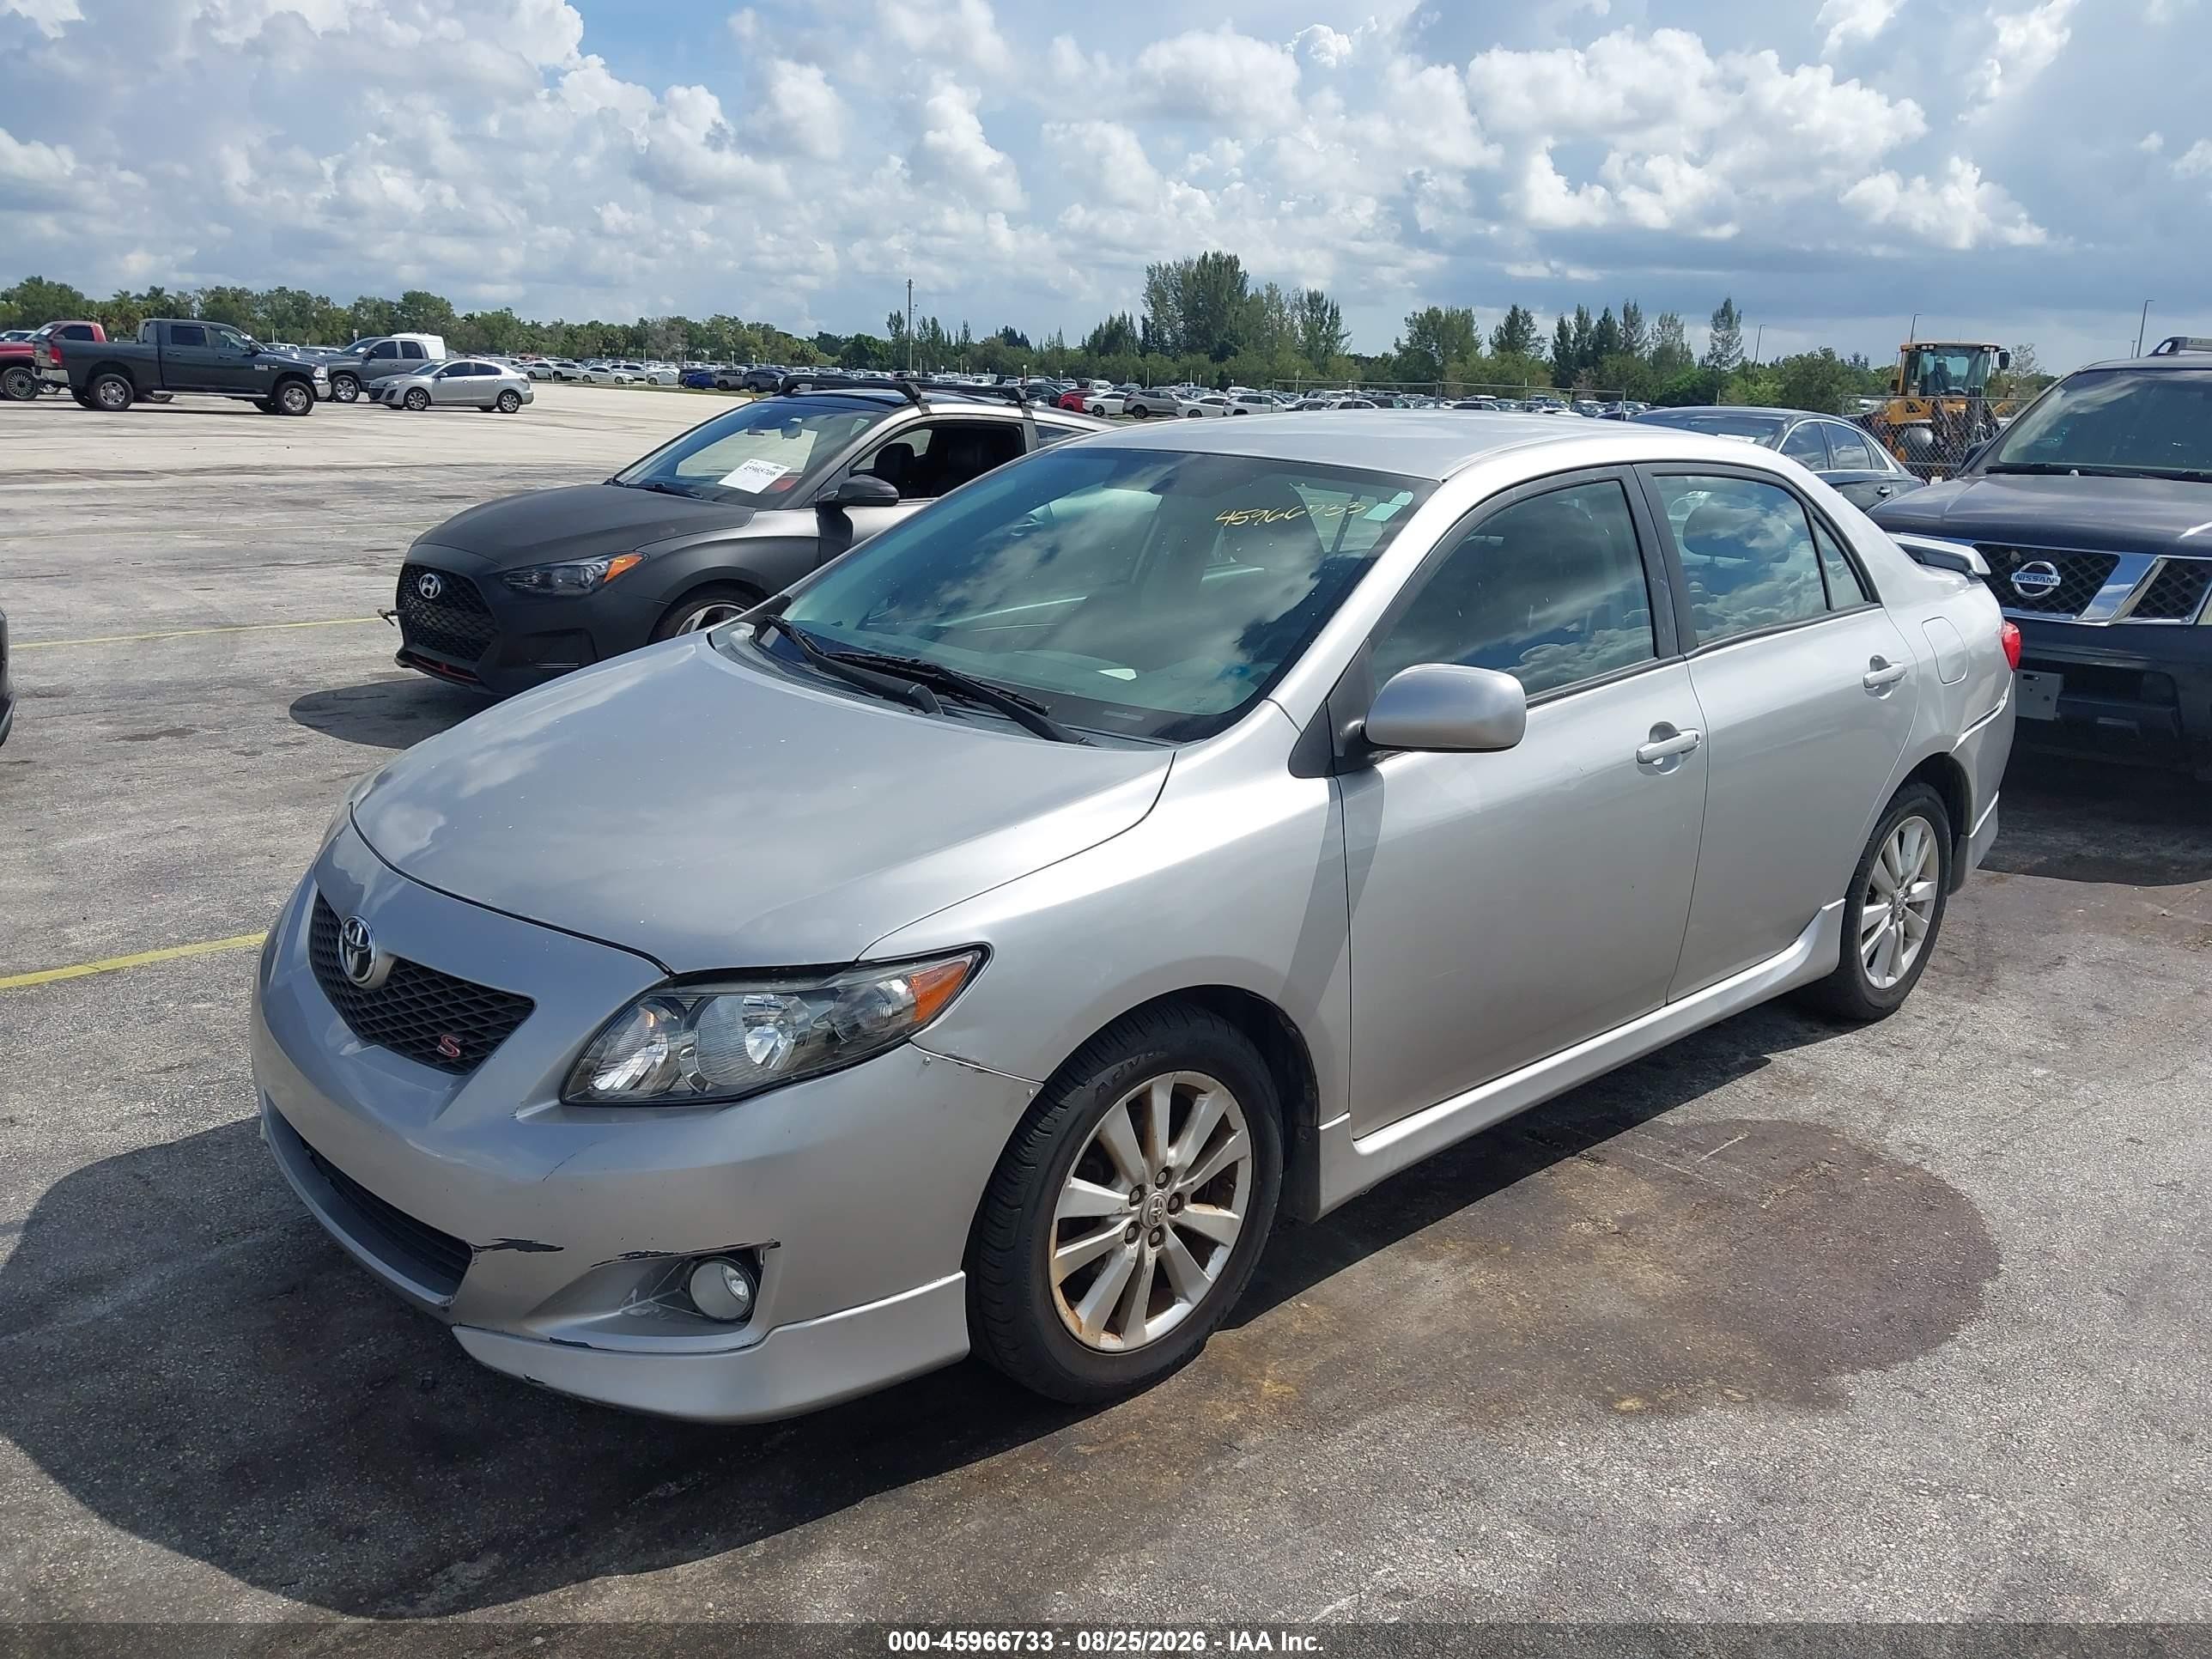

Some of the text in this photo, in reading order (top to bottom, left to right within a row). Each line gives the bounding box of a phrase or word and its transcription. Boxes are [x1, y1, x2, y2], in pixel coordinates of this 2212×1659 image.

[1214, 501, 1367, 526] 45966733
[2014, 573, 2055, 584] NISSAN
[436, 1034, 461, 1058] S
